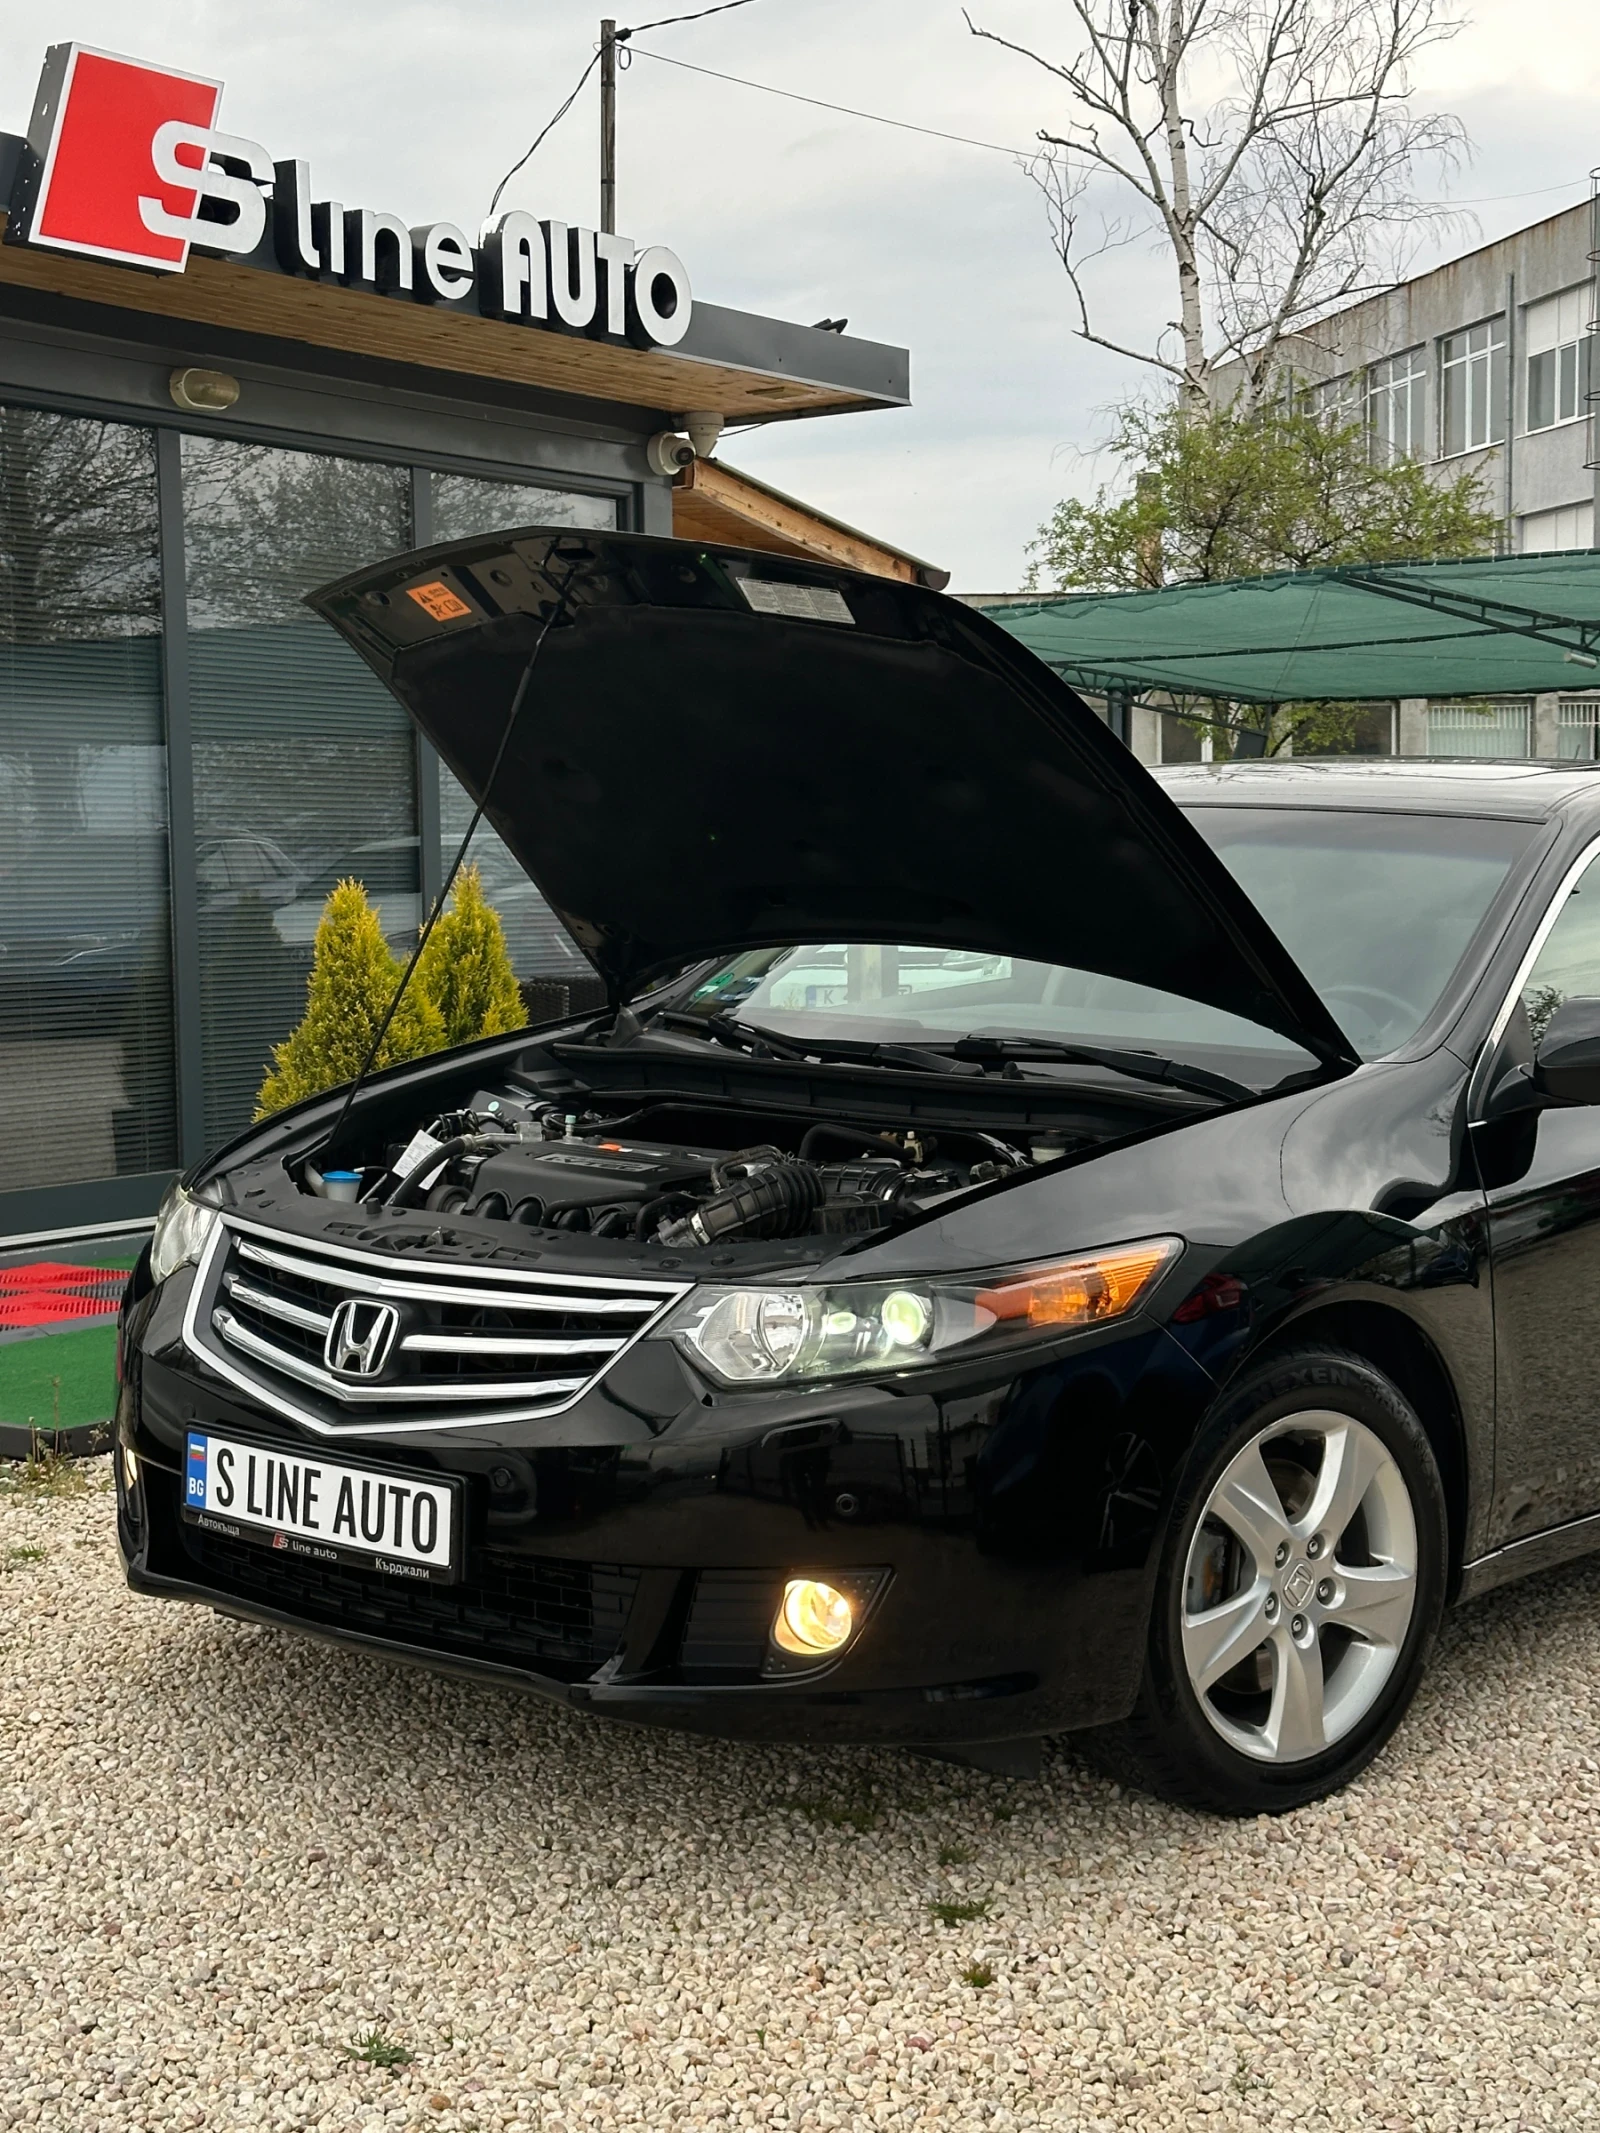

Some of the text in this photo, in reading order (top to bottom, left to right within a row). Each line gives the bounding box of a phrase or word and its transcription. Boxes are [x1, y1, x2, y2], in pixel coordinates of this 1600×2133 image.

[138, 120, 275, 253] S
[502, 209, 693, 347] AUTO
[188, 1476, 204, 1497] BG
[216, 1448, 438, 1554] S LINE AUTO
[197, 1514, 240, 1537] Автокъща
[292, 1540, 311, 1553] line
[313, 1548, 338, 1560] auto
[375, 1557, 430, 1579] Кърджали
